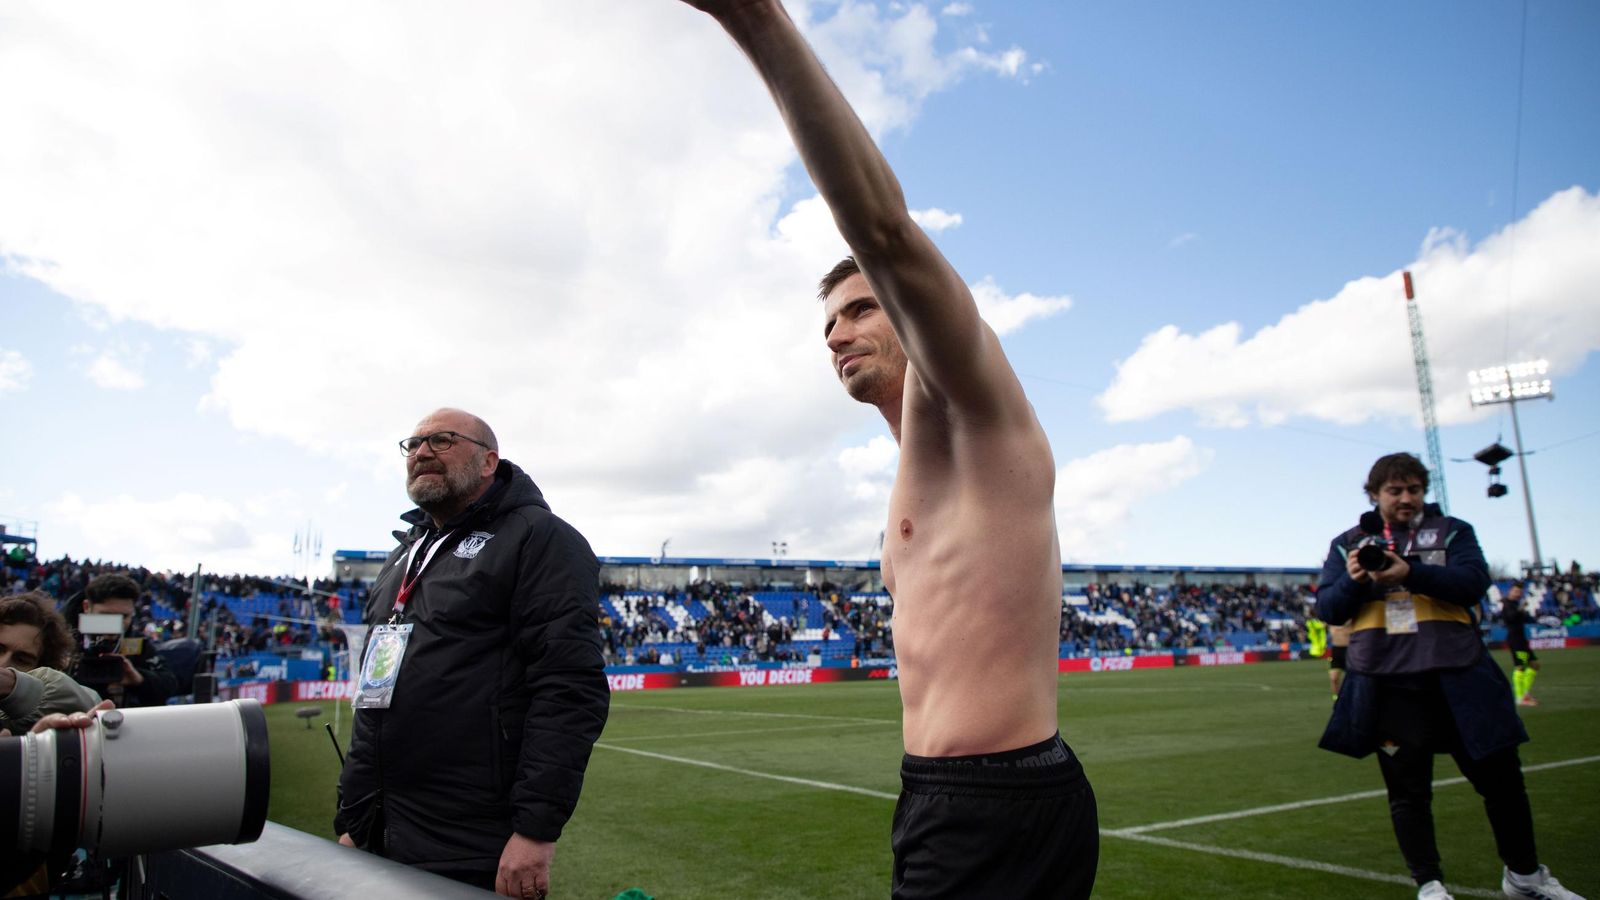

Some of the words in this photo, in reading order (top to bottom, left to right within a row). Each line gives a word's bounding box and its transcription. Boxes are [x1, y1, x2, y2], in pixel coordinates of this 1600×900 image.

[607, 674, 645, 690] ECIDE
[740, 669, 766, 686] YOU
[769, 669, 813, 684] DECIDE
